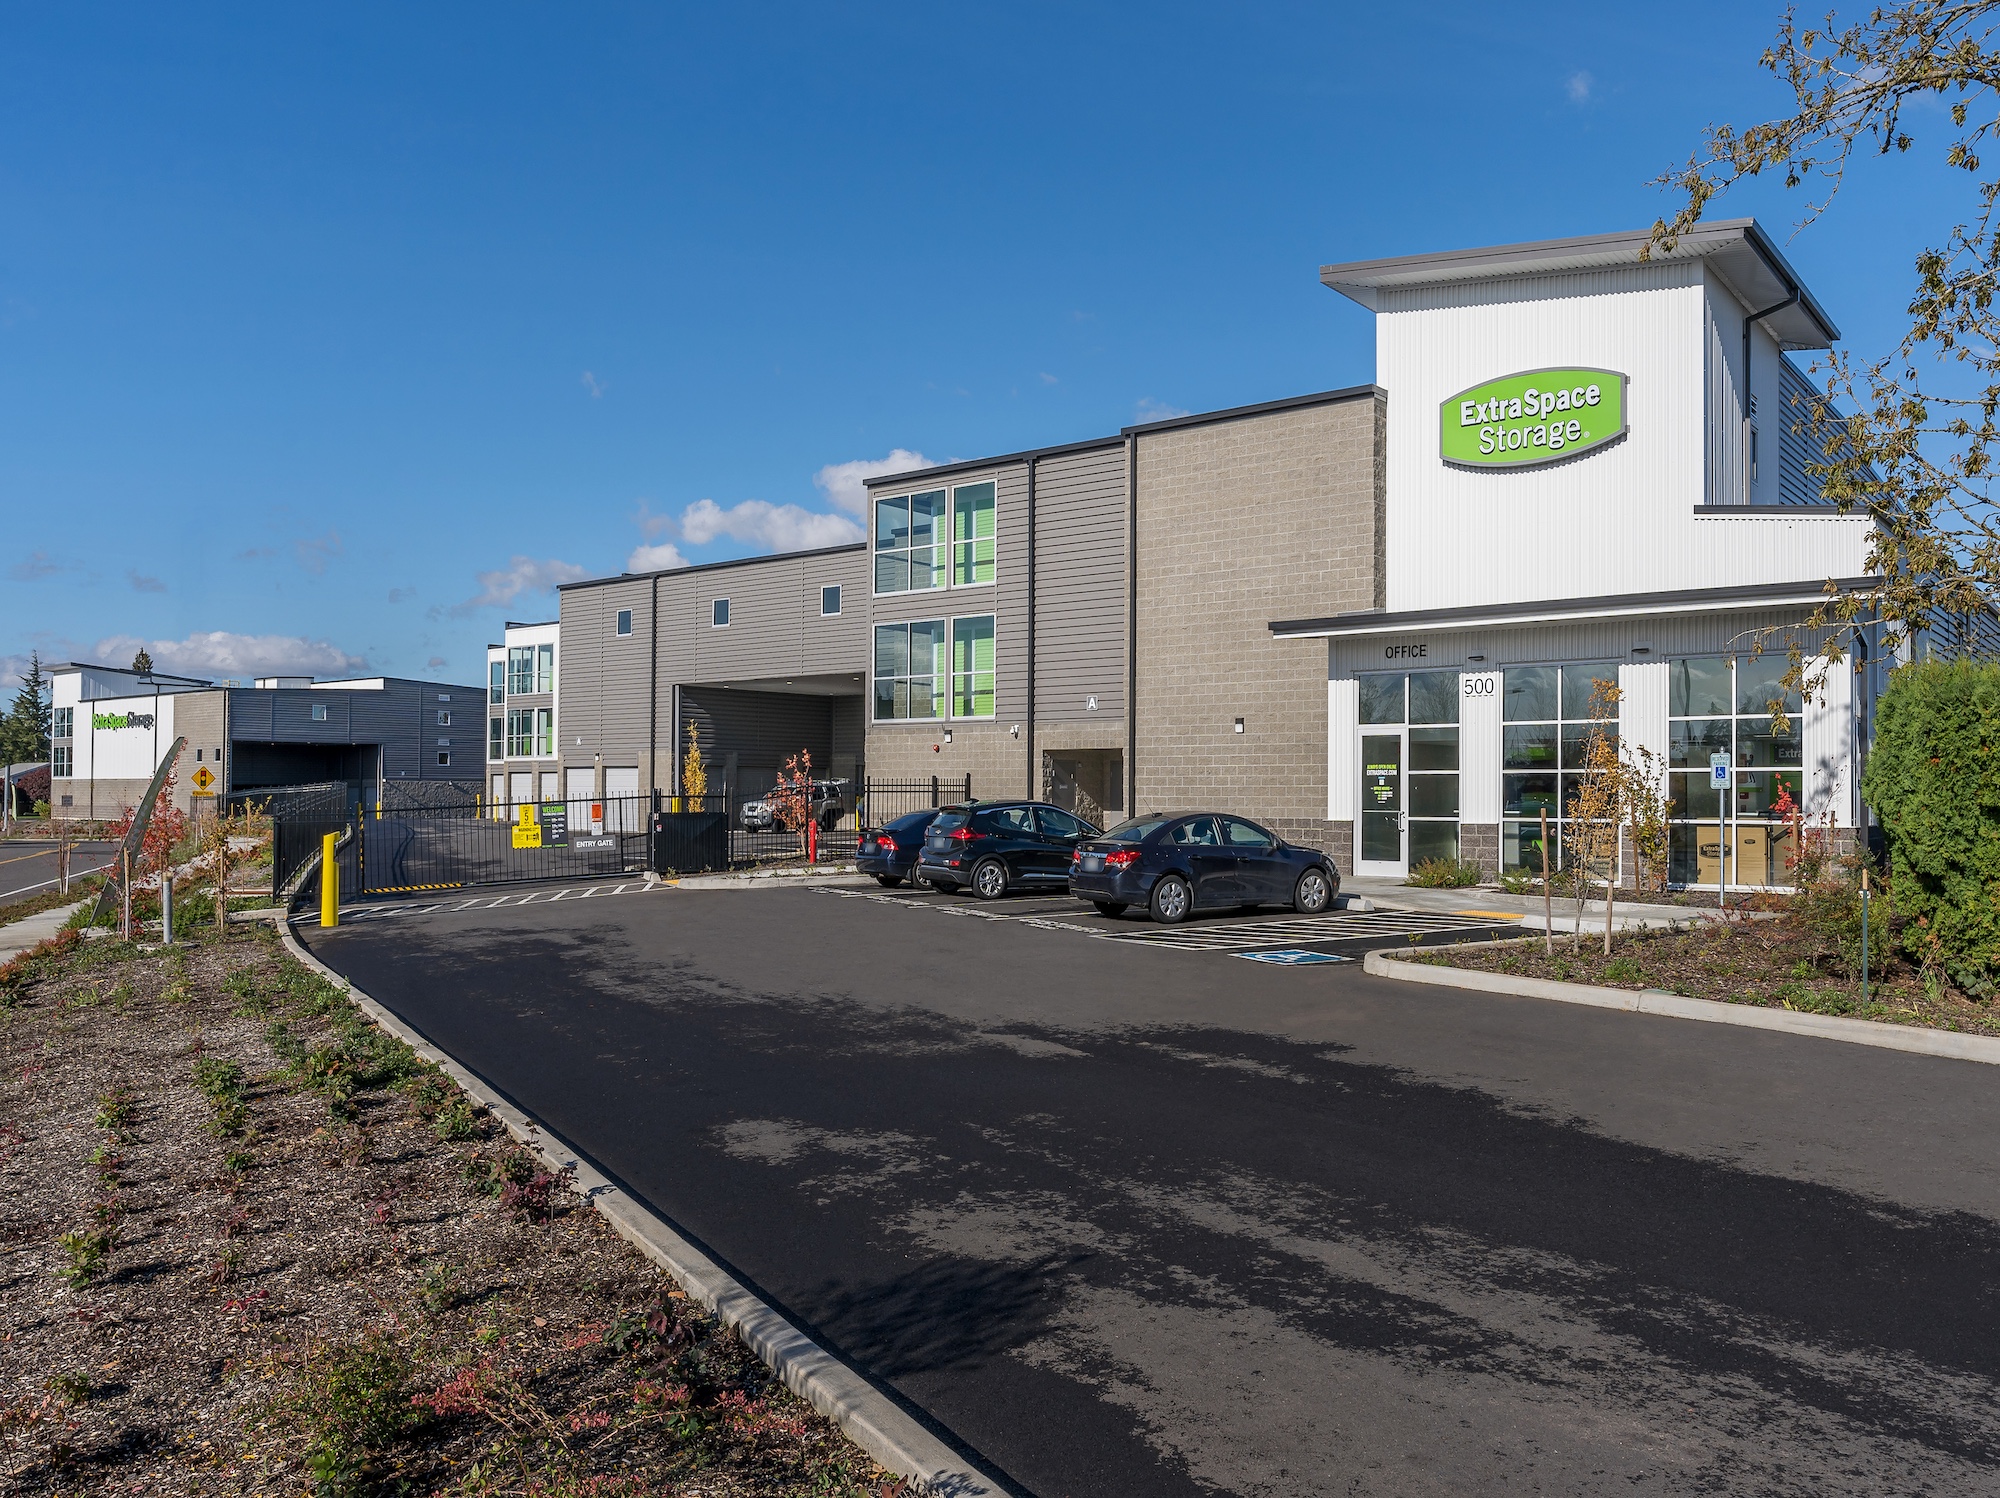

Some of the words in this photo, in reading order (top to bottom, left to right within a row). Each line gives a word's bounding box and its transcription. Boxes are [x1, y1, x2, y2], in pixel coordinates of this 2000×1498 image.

[1478, 419, 1581, 454] Storage
[1385, 644, 1427, 658] OFFICE
[1464, 678, 1494, 694] 500
[1088, 697, 1096, 709] A
[1778, 748, 1802, 758] Extra
[524, 812, 529, 821] 5
[576, 840, 596, 848] ENTRY
[597, 839, 614, 847] GATE
